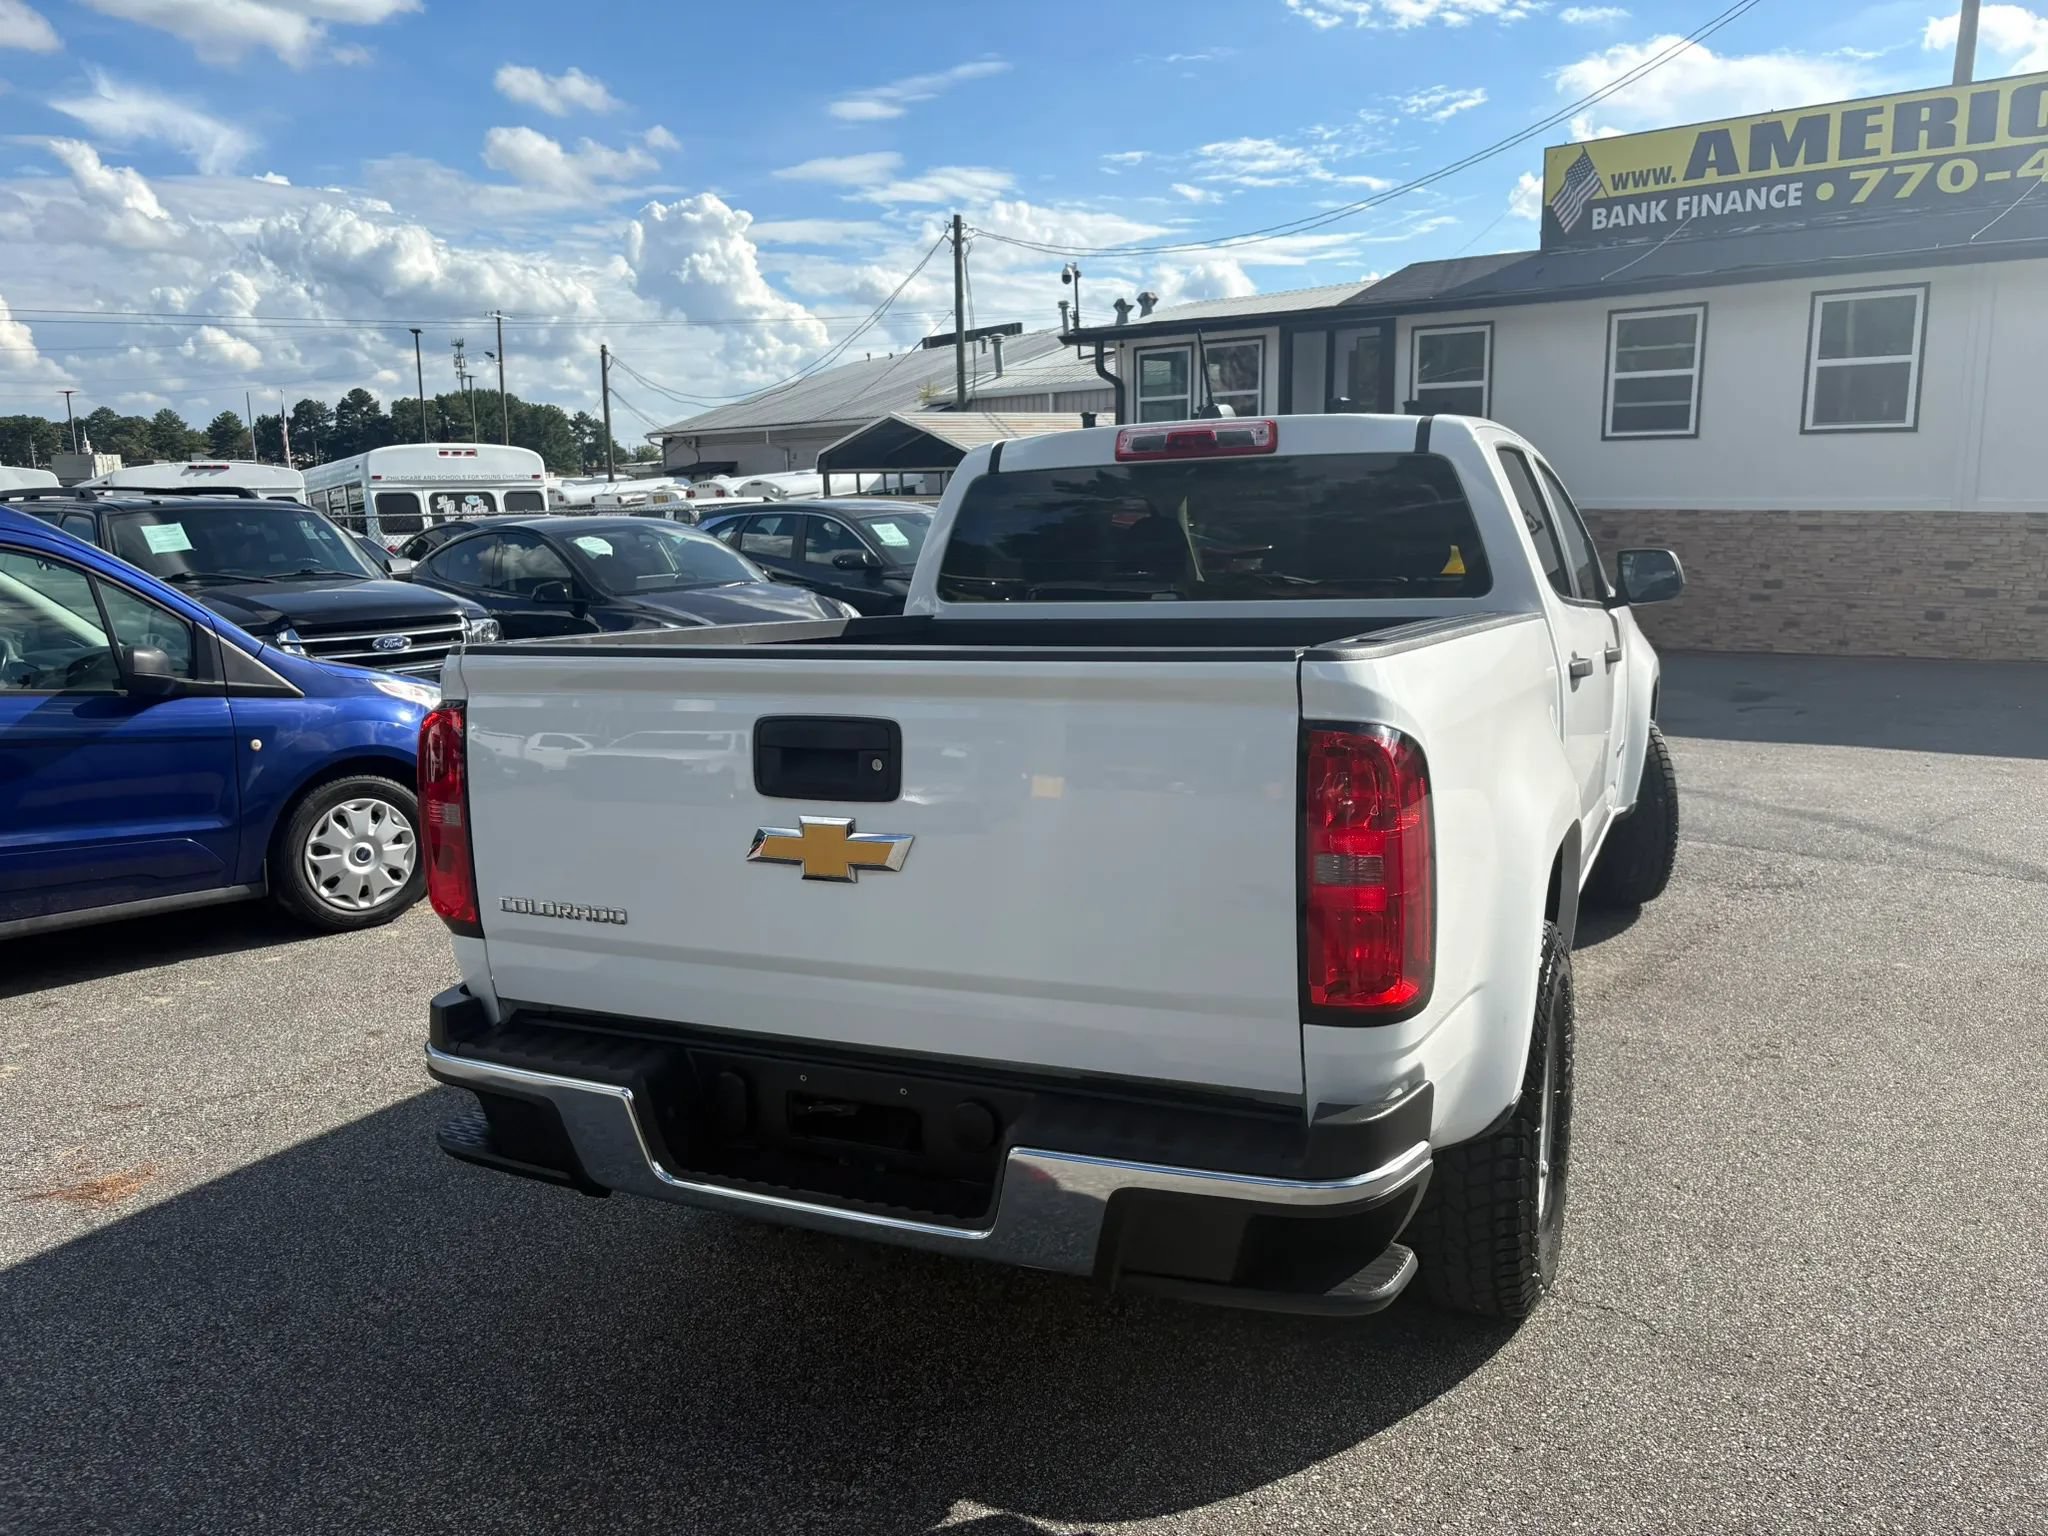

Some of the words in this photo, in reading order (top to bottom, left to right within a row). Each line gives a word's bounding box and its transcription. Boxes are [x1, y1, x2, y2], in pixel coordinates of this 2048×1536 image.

[1591, 199, 1668, 230] BANK
[1676, 182, 1804, 220] FINANCE
[1849, 149, 2048, 204] 770-4
[499, 896, 628, 925] COLORADO
